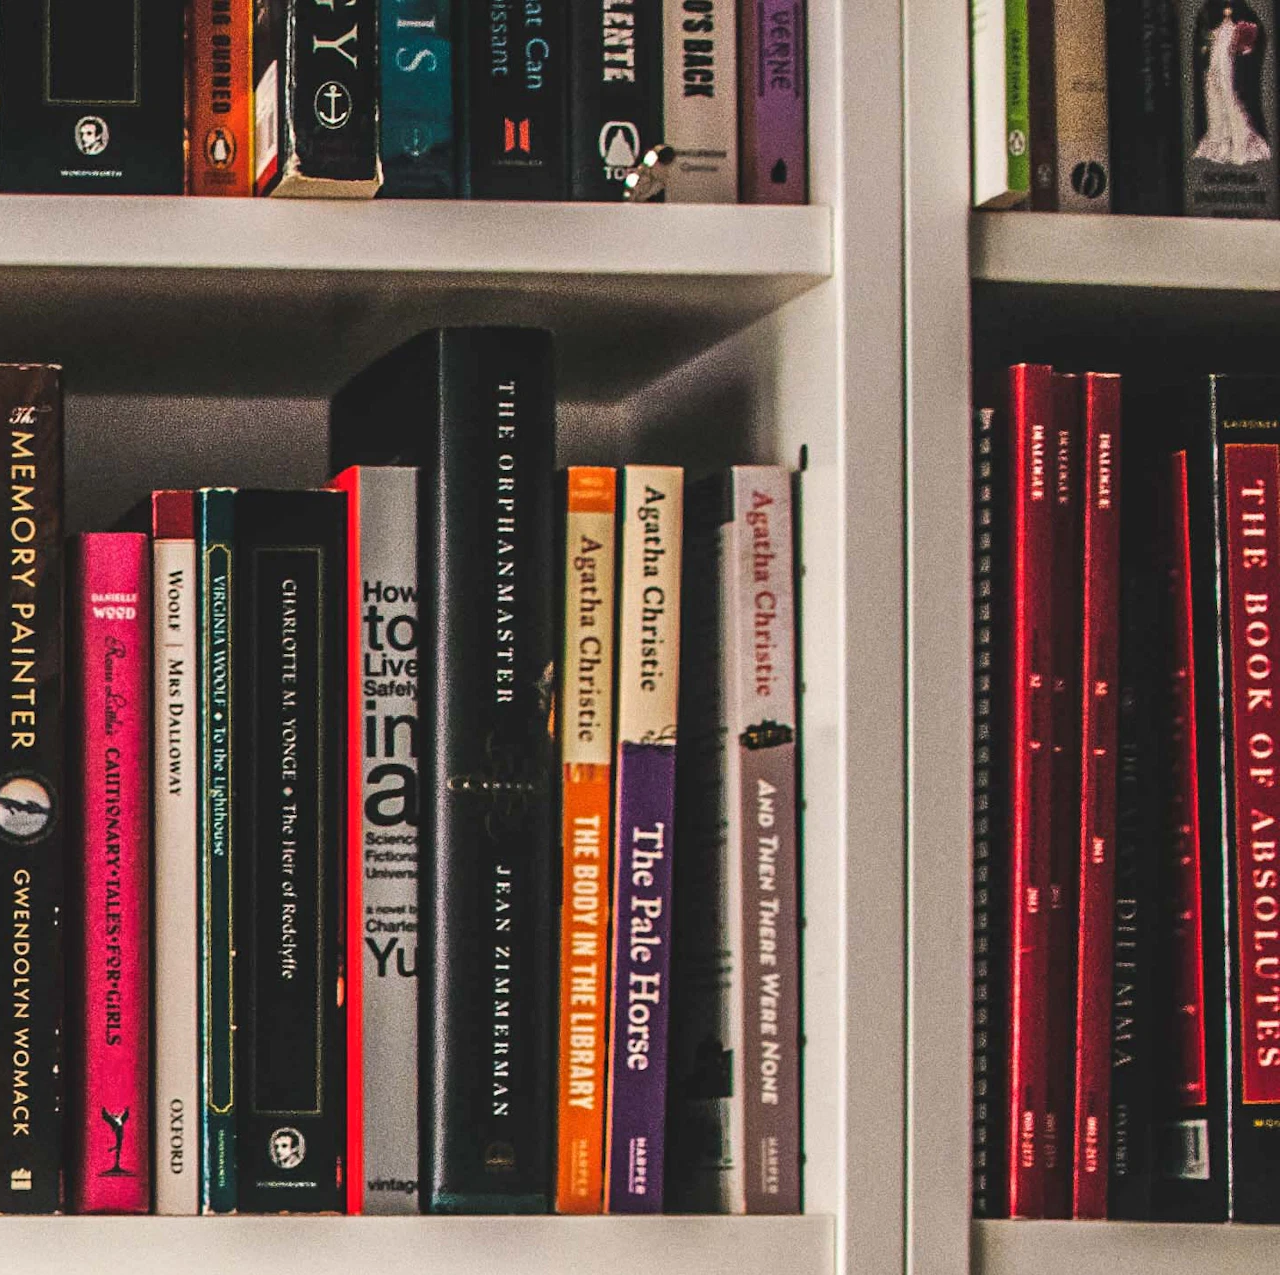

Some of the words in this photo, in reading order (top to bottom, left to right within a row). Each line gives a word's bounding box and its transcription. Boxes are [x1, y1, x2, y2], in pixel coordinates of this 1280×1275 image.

[525, 38, 550, 89] Can
[683, 40, 714, 98] BACK
[7, 432, 37, 587] MEMORY
[638, 486, 666, 582] Agatha
[1239, 480, 1266, 569] THE
[8, 603, 38, 751] PAINTER
[639, 586, 665, 693] Christie
[1244, 593, 1273, 713] BOOK
[1247, 734, 1275, 790] OF
[630, 821, 665, 893] The
[11, 869, 31, 1020] GWENDOLYN
[627, 898, 662, 963] Pale
[1250, 808, 1280, 1069] ABSOLUTES
[626, 971, 660, 1071] Horse
[11, 1029, 32, 1137] WOMACK
[169, 1099, 185, 1176] OXFORD
